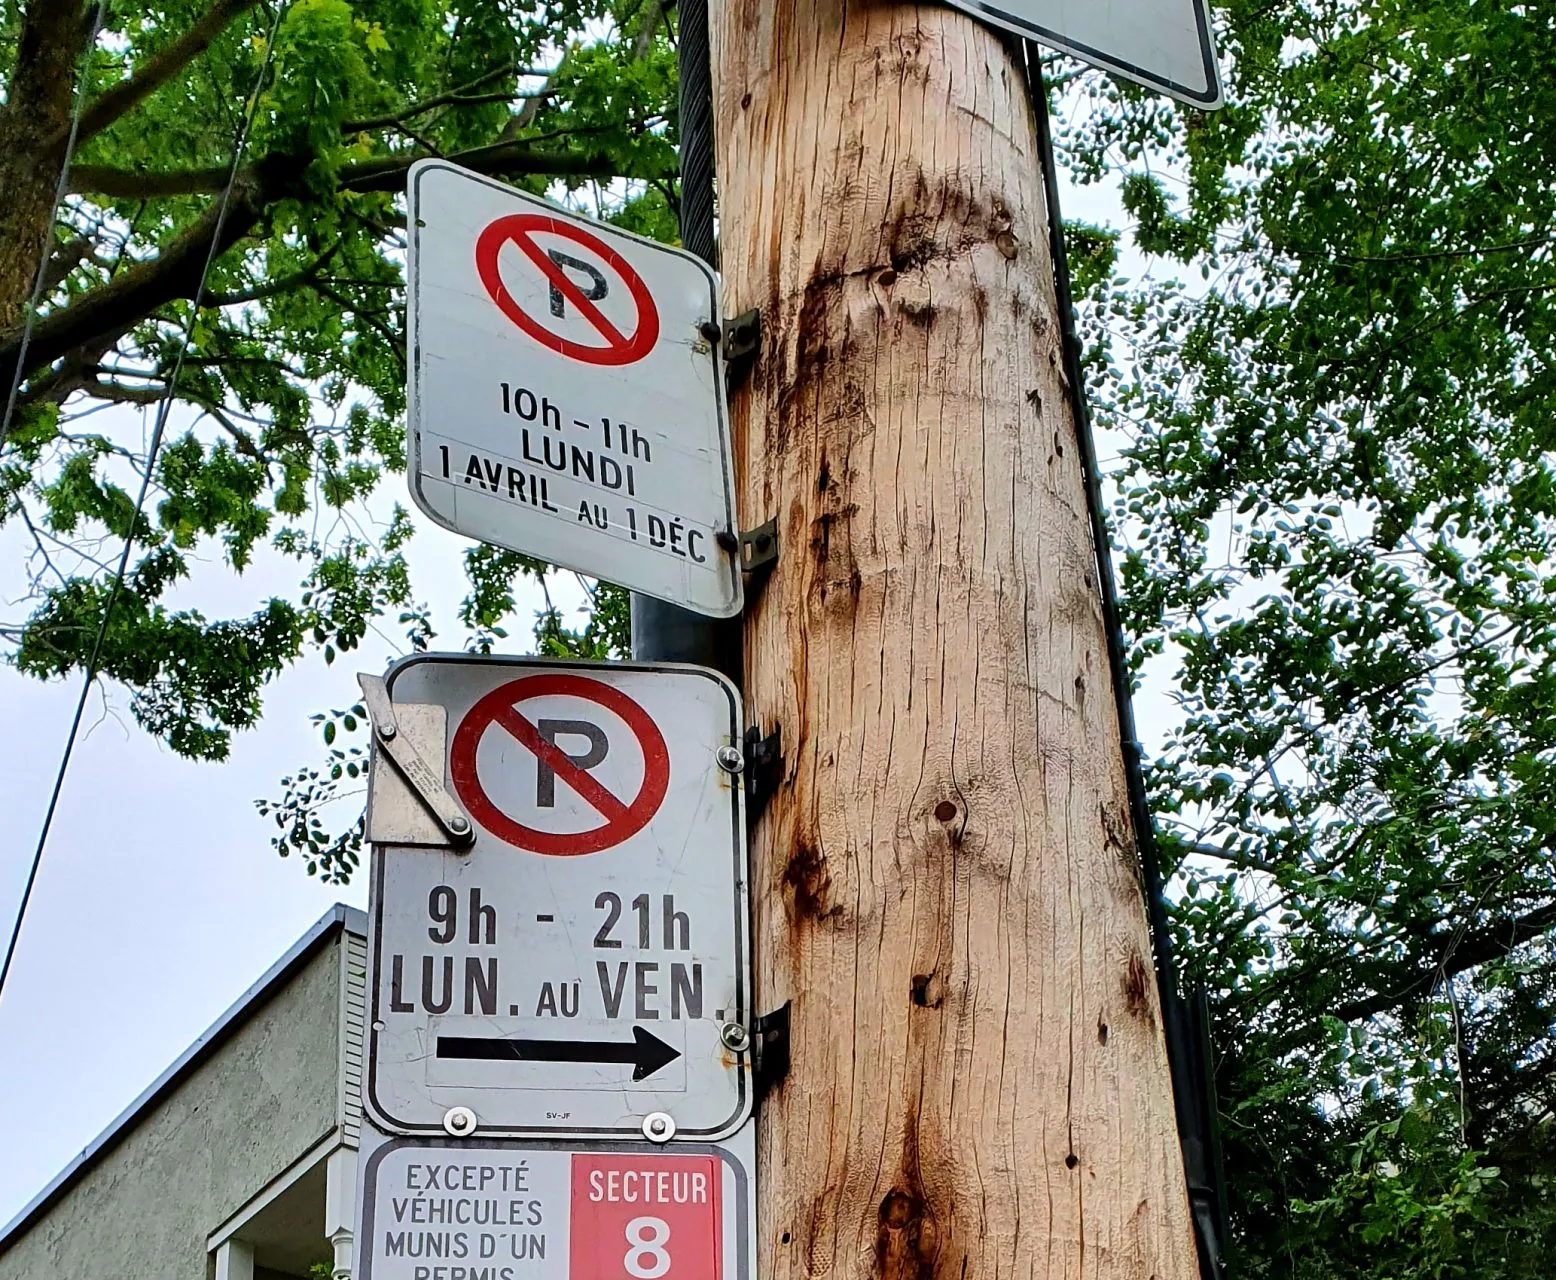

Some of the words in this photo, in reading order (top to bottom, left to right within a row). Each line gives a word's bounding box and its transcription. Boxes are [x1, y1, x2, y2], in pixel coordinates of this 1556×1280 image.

[500, 382, 561, 430] 10h
[601, 418, 651, 462] 11h
[522, 429, 634, 496] LUNDI
[439, 445, 449, 478] 1
[465, 454, 558, 513] AVRIL
[579, 500, 607, 529] AU
[626, 508, 637, 539] 1
[649, 517, 706, 563] DÉC
[428, 886, 496, 944] 9h
[594, 892, 689, 951] 21h
[391, 955, 518, 1016] LUN.
[536, 982, 579, 1017] AU
[407, 1160, 529, 1192] EXCEPTÉ
[589, 1170, 707, 1203] SECTEUR
[392, 1192, 543, 1226] VÉHICULES
[386, 1232, 468, 1258] MUNIS
[623, 1216, 671, 1279] 8
